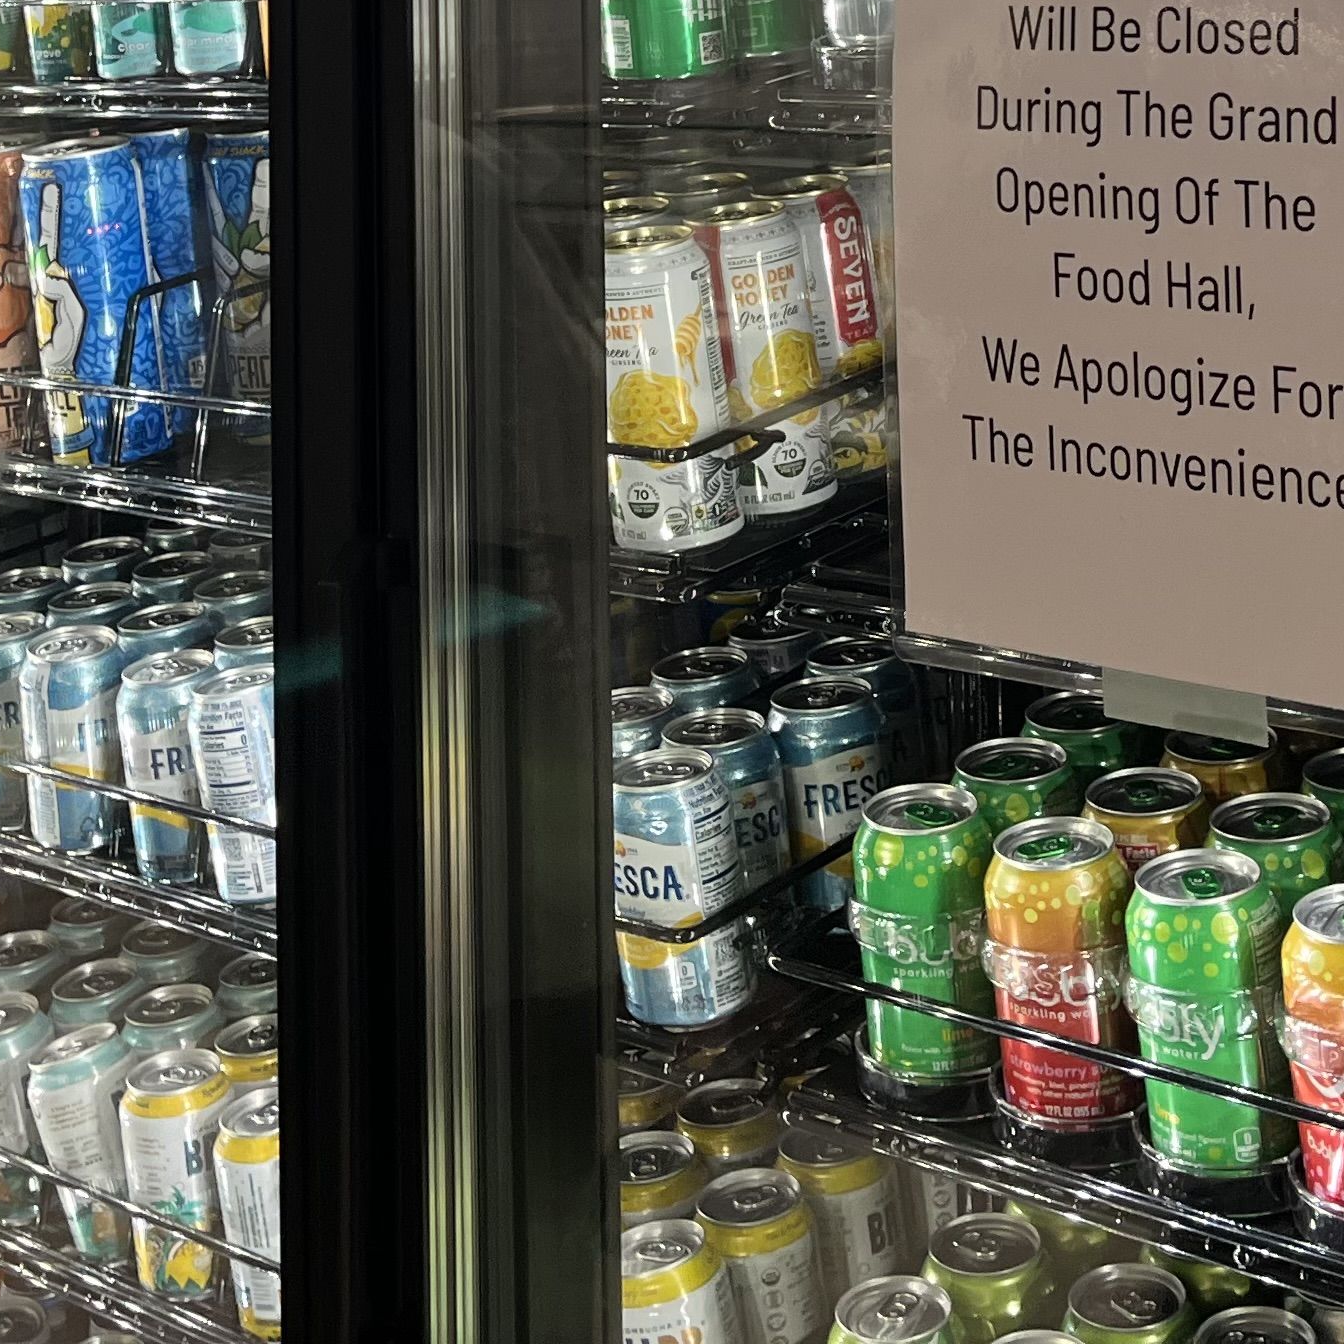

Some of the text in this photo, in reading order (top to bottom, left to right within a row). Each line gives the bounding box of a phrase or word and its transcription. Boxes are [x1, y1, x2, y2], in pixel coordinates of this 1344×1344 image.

[1009, 6, 1299, 55] Will Be Closed
[978, 86, 1336, 147] During The Grand
[997, 167, 1315, 234] Opening Of The
[731, 263, 796, 289] GODEN
[734, 284, 790, 308] HOEY
[1054, 252, 1254, 320] Food Hall,
[982, 336, 1343, 419] We Apologize For
[781, 448, 798, 460] 70
[962, 415, 1033, 467] The
[893, 965, 953, 978] sparkling
[1161, 1044, 1202, 1061] water
